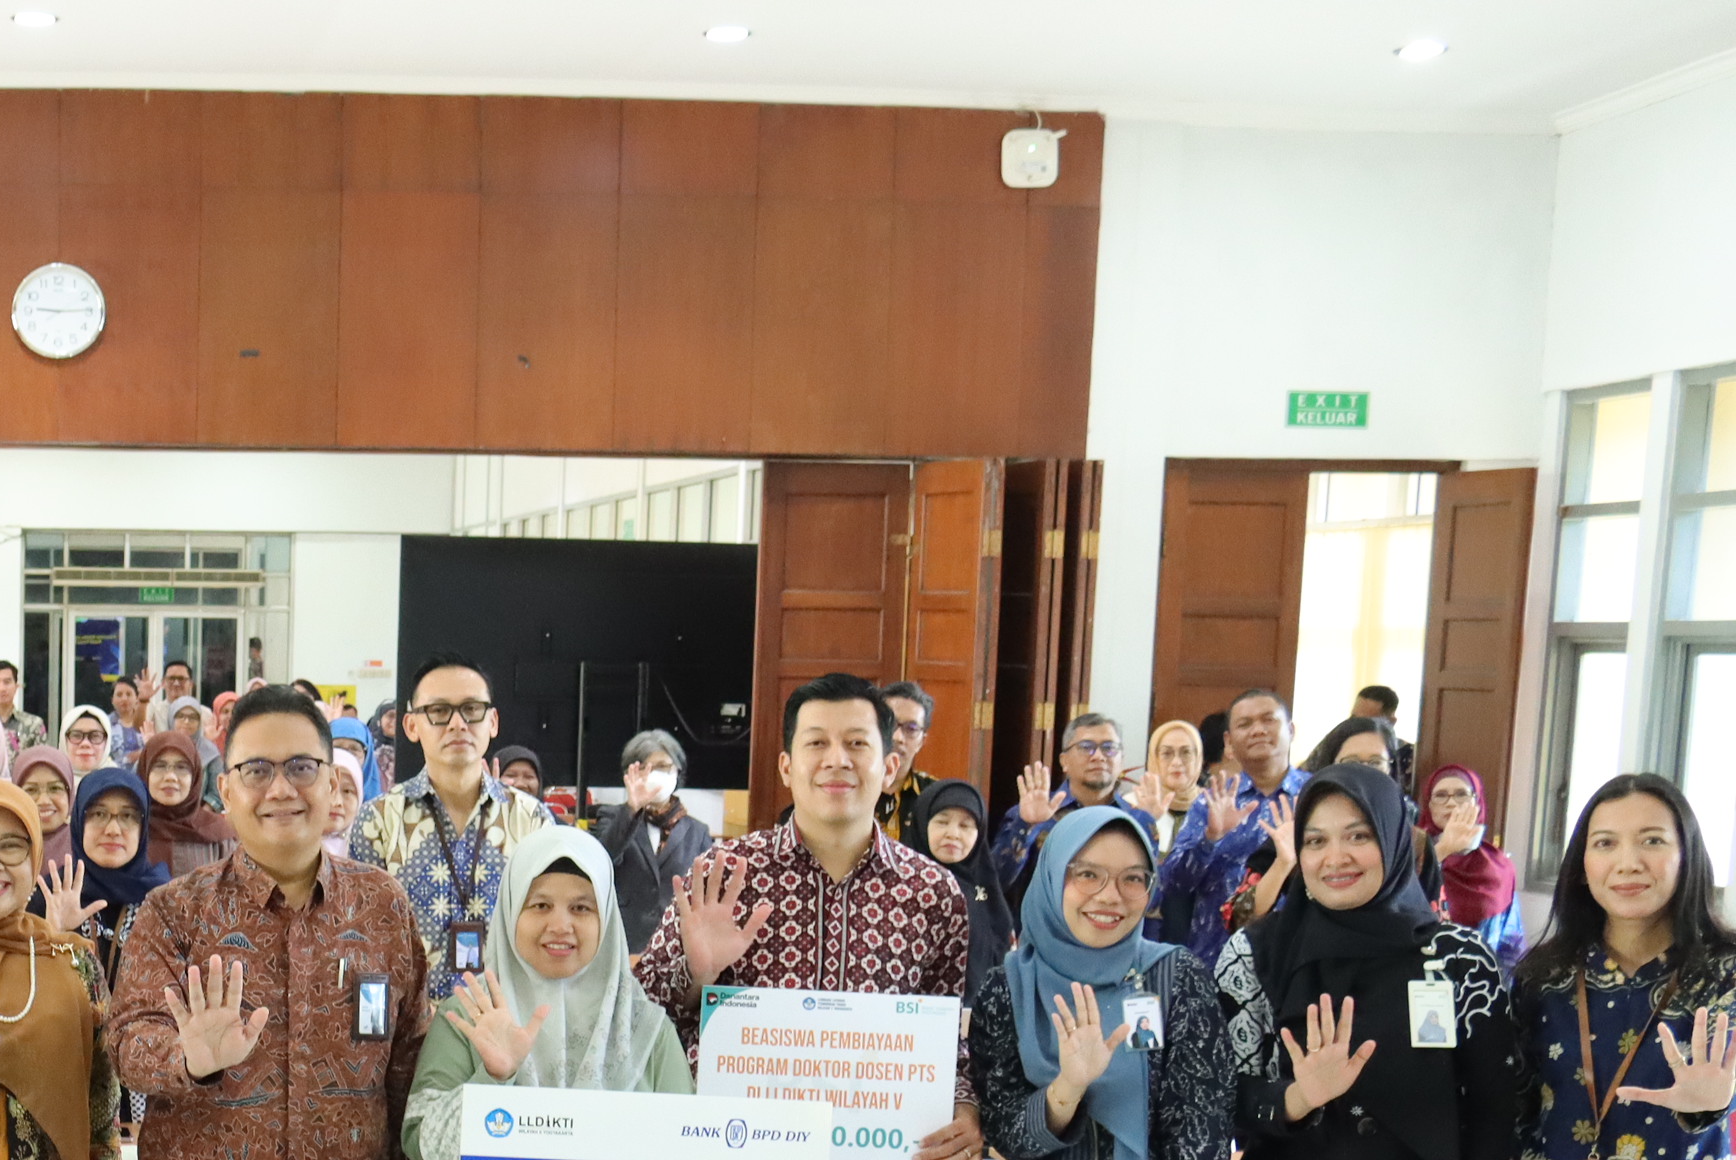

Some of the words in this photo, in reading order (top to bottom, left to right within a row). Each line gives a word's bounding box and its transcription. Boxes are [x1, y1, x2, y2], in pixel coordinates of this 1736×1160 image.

[1297, 394, 1359, 408] EXIT
[1296, 411, 1357, 425] KELUAR
[721, 992, 759, 1000] Danantara
[720, 1000, 757, 1008] Indonesia
[896, 1002, 919, 1014] BSI
[741, 1027, 815, 1047] BEASISWA
[821, 1031, 913, 1051] PEMBIAYAAN
[717, 1056, 788, 1075] PROGRAM
[793, 1059, 851, 1078] DOKTOR
[856, 1062, 903, 1080] DOSEN
[908, 1064, 935, 1082] PTS
[825, 1089, 889, 1109] WILAYAH
[894, 1093, 902, 1110] V
[518, 1114, 574, 1129] LLDIKTI
[681, 1126, 720, 1138] BANK
[752, 1129, 781, 1141] BPD
[786, 1131, 810, 1142] DIY
